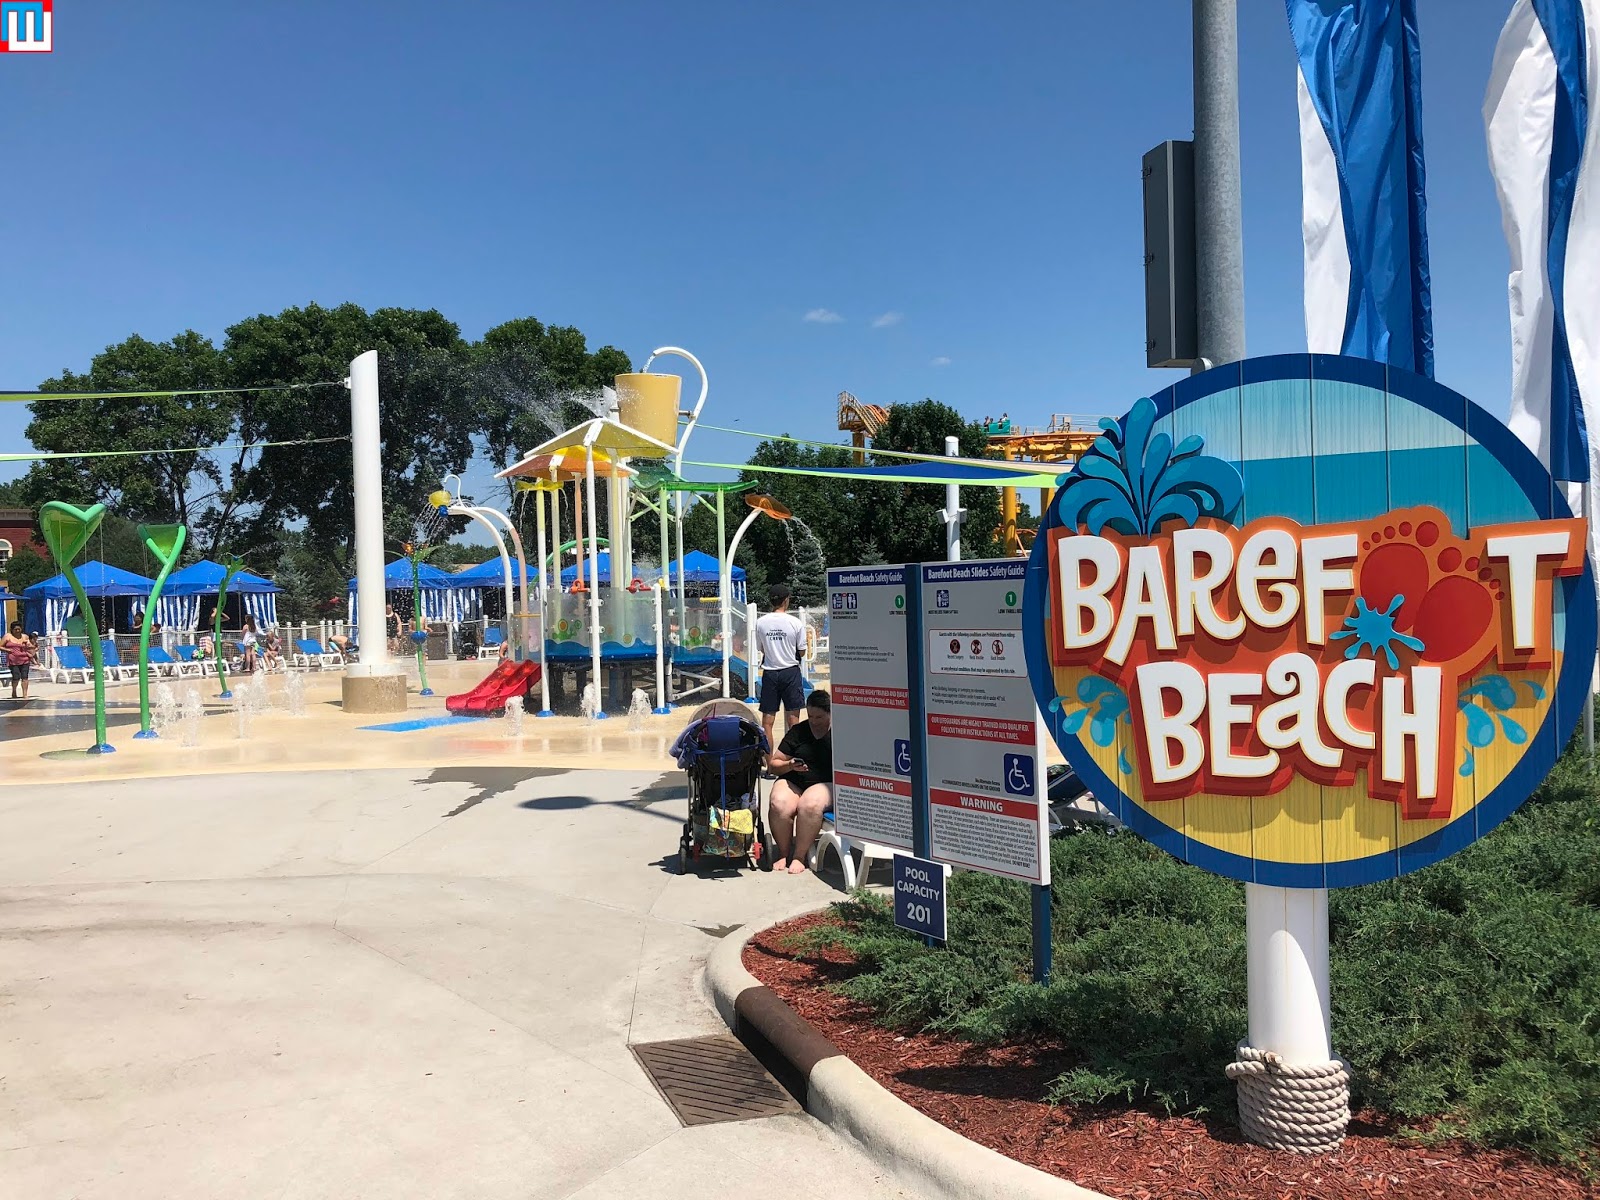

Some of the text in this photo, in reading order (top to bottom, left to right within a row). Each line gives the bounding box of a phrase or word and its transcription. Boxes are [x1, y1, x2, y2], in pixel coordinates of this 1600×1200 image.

[839, 572, 902, 584] Barefoot Beach Safety Guide
[928, 565, 1024, 579] Barefoot Beach Slides Safety Guide
[1136, 652, 1442, 799] BEACH
[858, 778, 894, 792] WARNING
[960, 796, 1003, 812] WARNING
[905, 866, 930, 883] POOL
[897, 880, 940, 901] CAPACITY
[906, 902, 931, 925] 201
